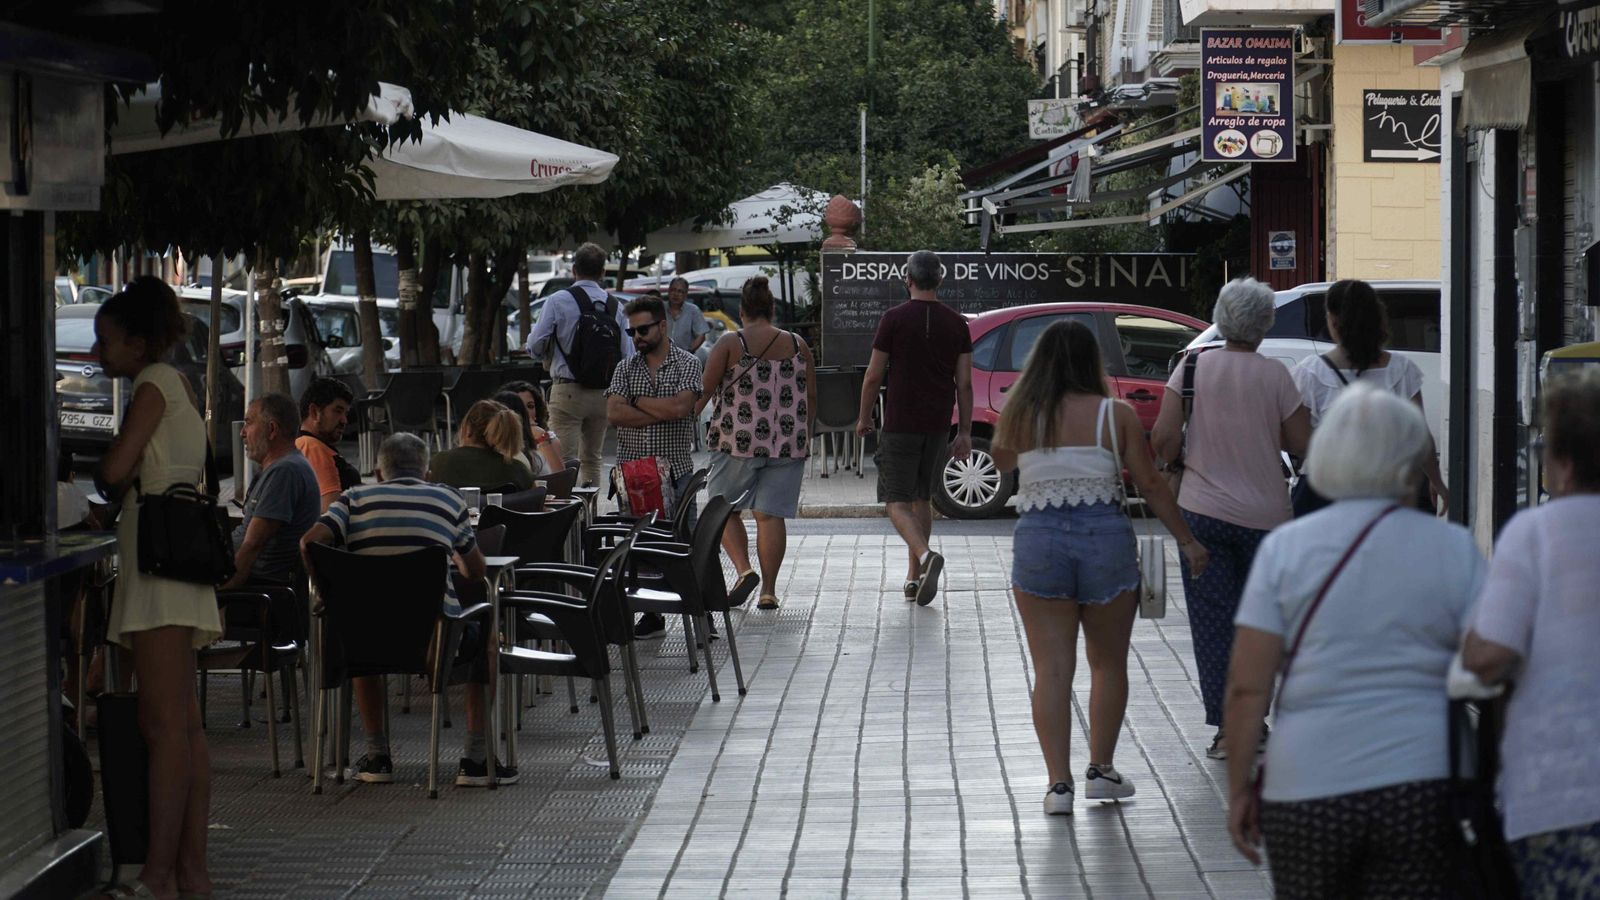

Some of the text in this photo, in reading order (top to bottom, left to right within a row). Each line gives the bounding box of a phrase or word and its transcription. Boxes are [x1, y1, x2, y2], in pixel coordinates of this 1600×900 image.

[1206, 36, 1291, 49] BAZAR OMAIMA
[1206, 55, 1287, 67] Articulos de regalos
[1410, 95, 1419, 106] &
[1208, 116, 1286, 128] Arreglo de ropa
[954, 262, 979, 280] DE
[1064, 255, 1186, 288] SINAI
[61, 413, 85, 425] 7954
